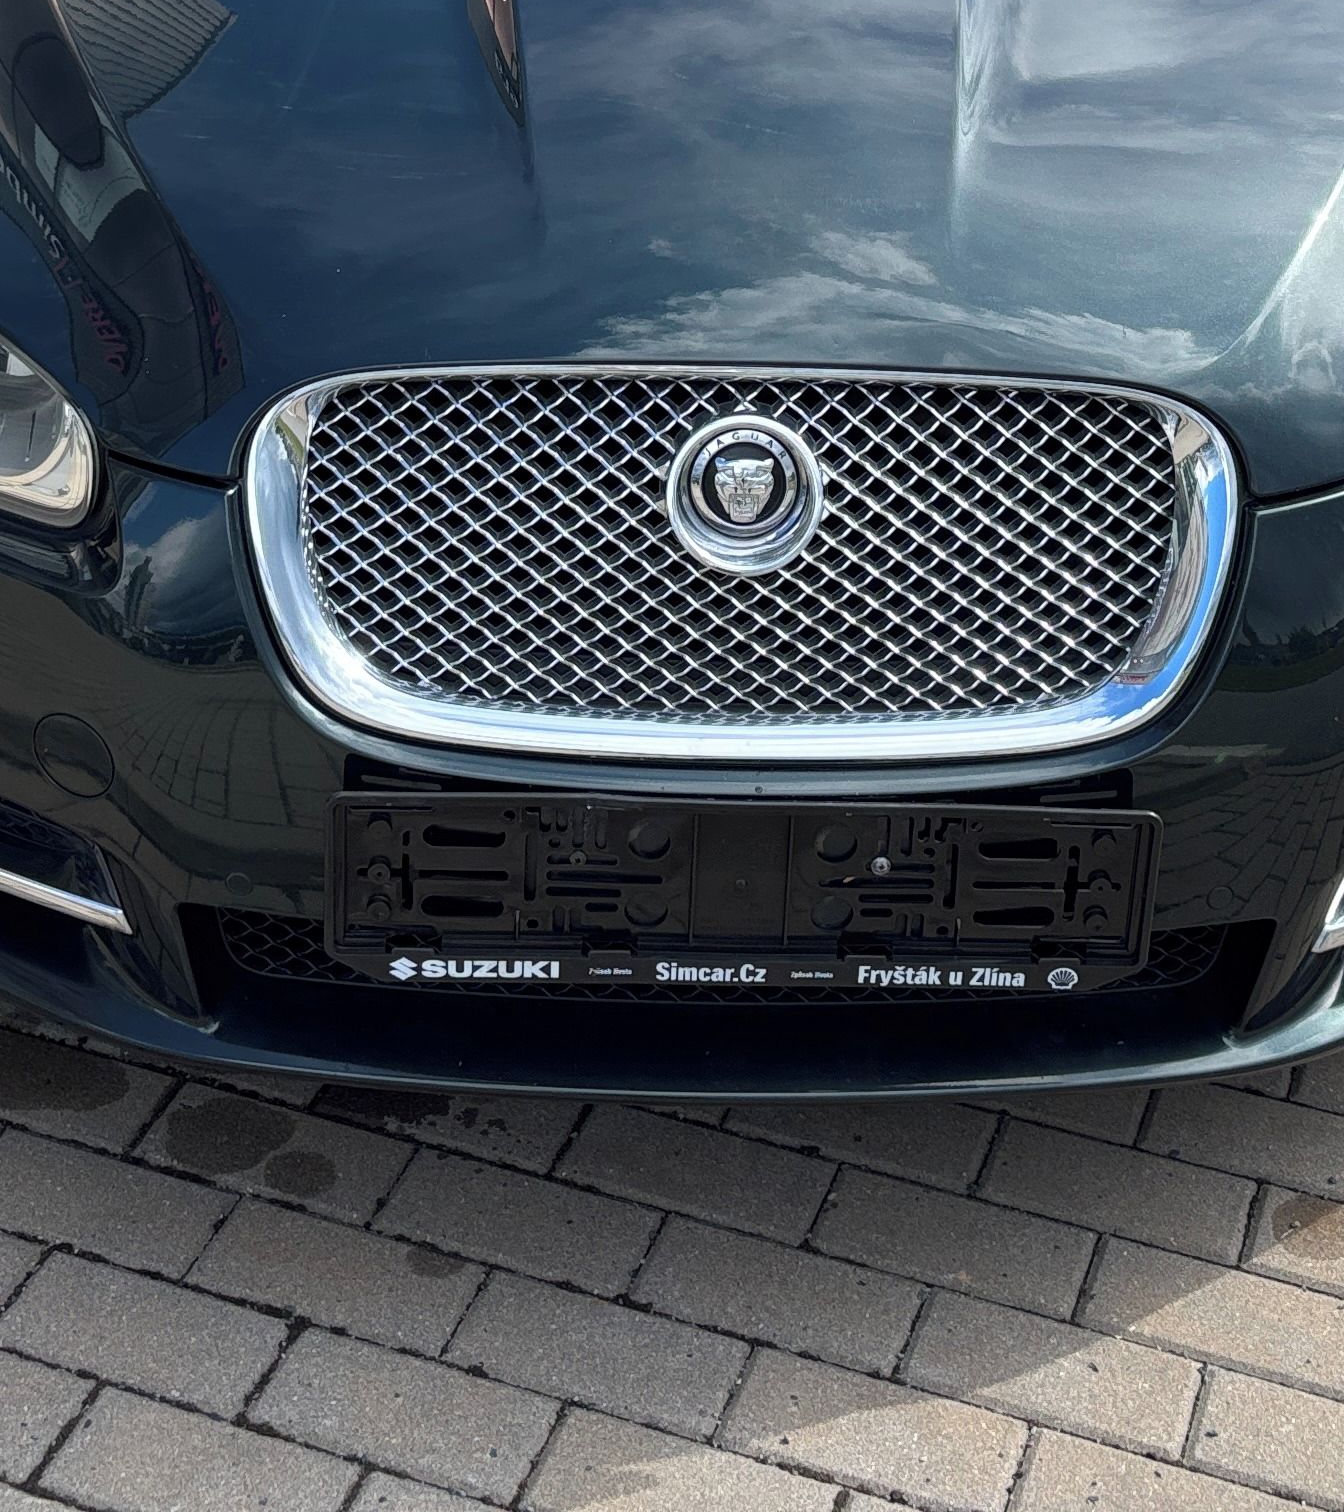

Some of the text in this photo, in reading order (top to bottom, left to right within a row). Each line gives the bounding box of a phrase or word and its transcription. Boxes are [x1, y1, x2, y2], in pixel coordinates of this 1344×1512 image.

[704, 431, 787, 458] JAGUAR
[421, 960, 560, 979] SUZUKI
[655, 962, 767, 982] Simcar.Cz
[857, 964, 1026, 987] Fryšták u Zlína
